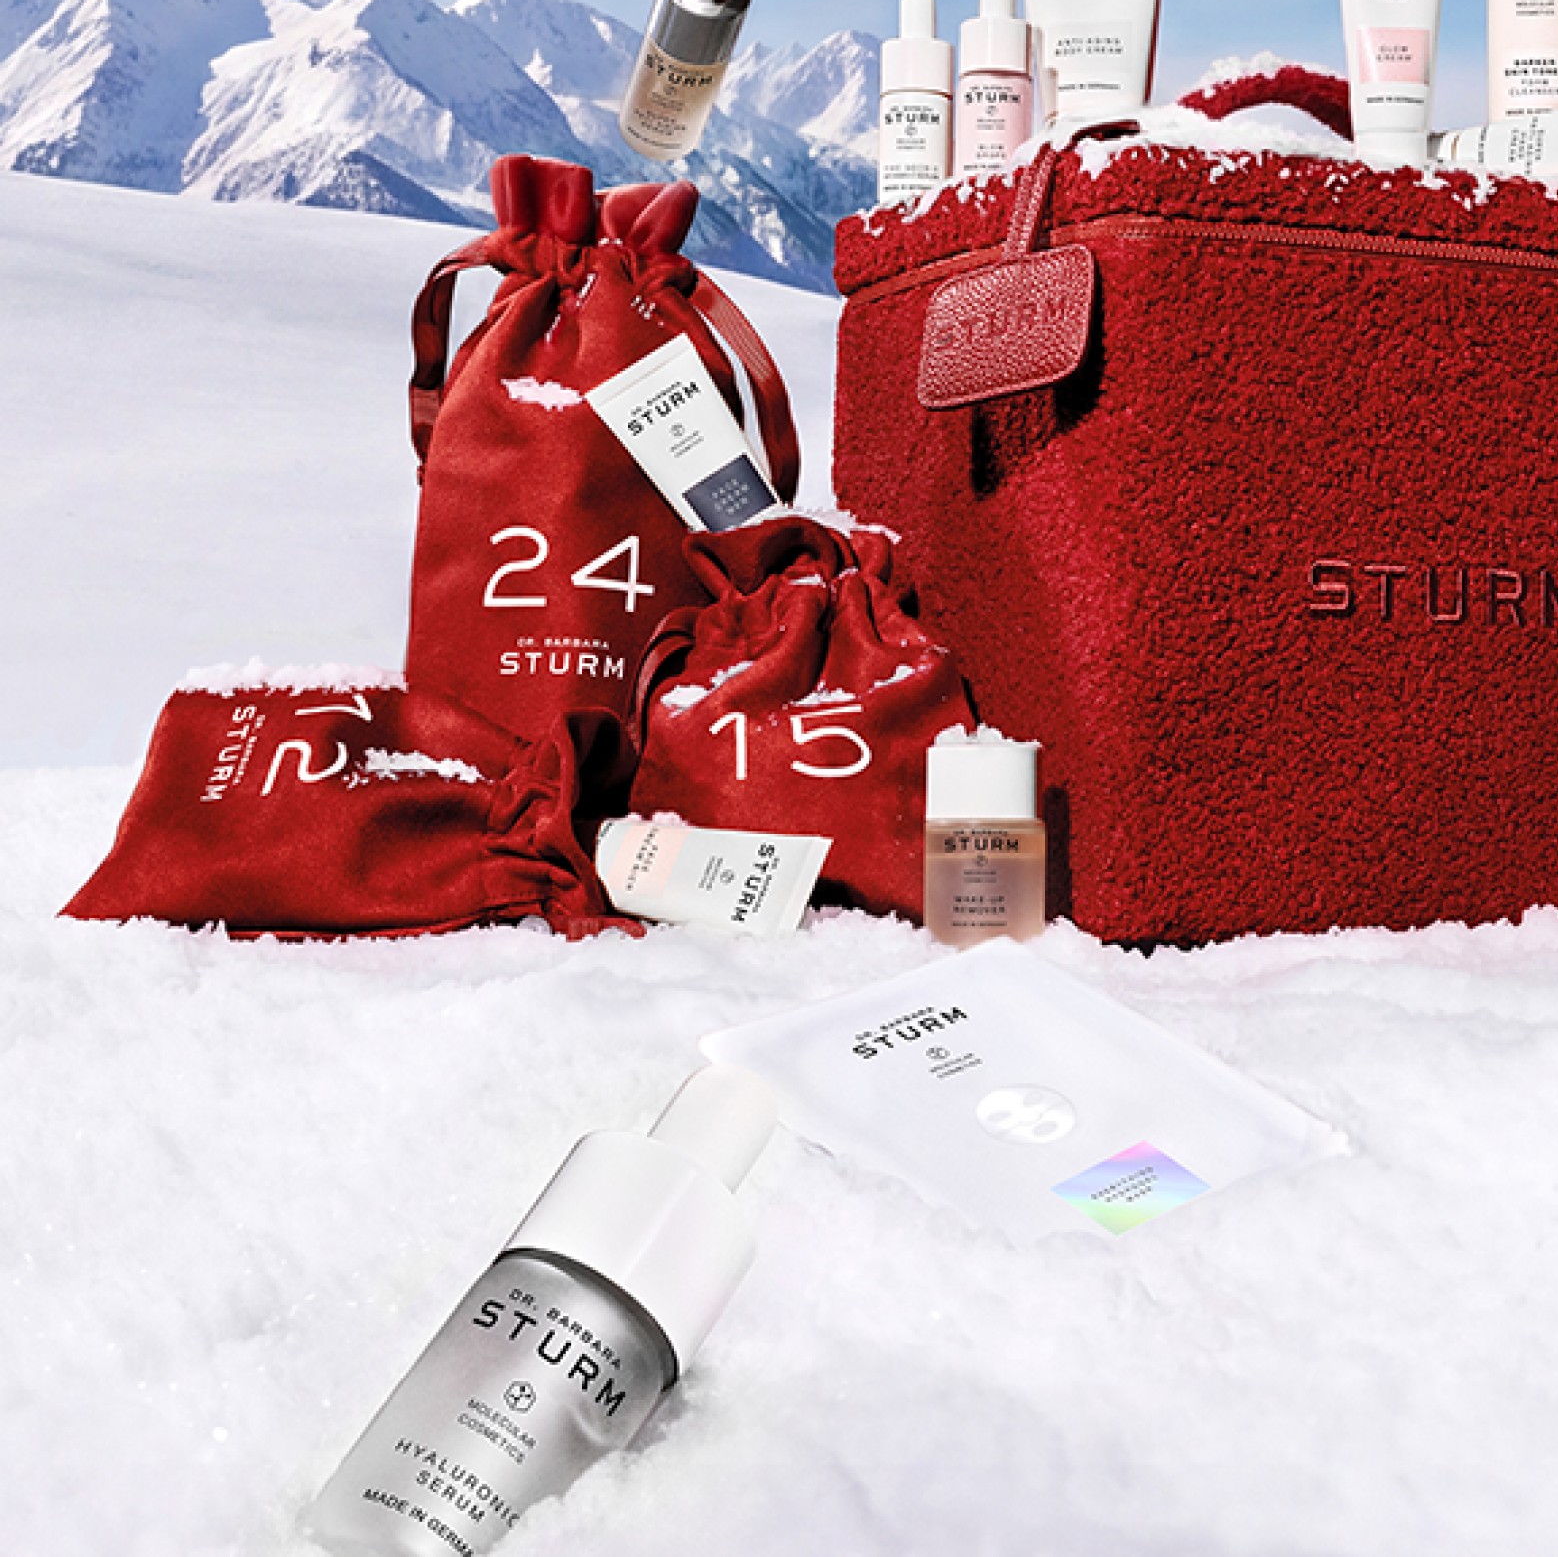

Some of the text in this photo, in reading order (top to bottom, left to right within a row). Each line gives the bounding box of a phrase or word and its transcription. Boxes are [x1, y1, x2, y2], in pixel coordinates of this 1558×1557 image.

[885, 113, 941, 125] STURM
[964, 92, 1022, 104] STURM
[627, 381, 702, 436] STURM
[483, 525, 656, 612] 24
[499, 652, 625, 680] STURM
[543, 635, 610, 650] BARBARA
[200, 704, 257, 803] STURM
[260, 693, 372, 797] 12
[708, 704, 873, 781] 15
[944, 837, 1019, 853] STURM
[731, 841, 776, 922] STURM
[852, 1005, 969, 1060] STURM
[508, 1287, 622, 1370] DR. BARBARA
[473, 1299, 627, 1417] STURM
[456, 1412, 527, 1465] COSMETICS
[466, 1397, 538, 1450] MOLECULAR
[362, 1487, 409, 1515] MADE
[408, 1505, 429, 1524] IN
[415, 1468, 487, 1524] SERUM
